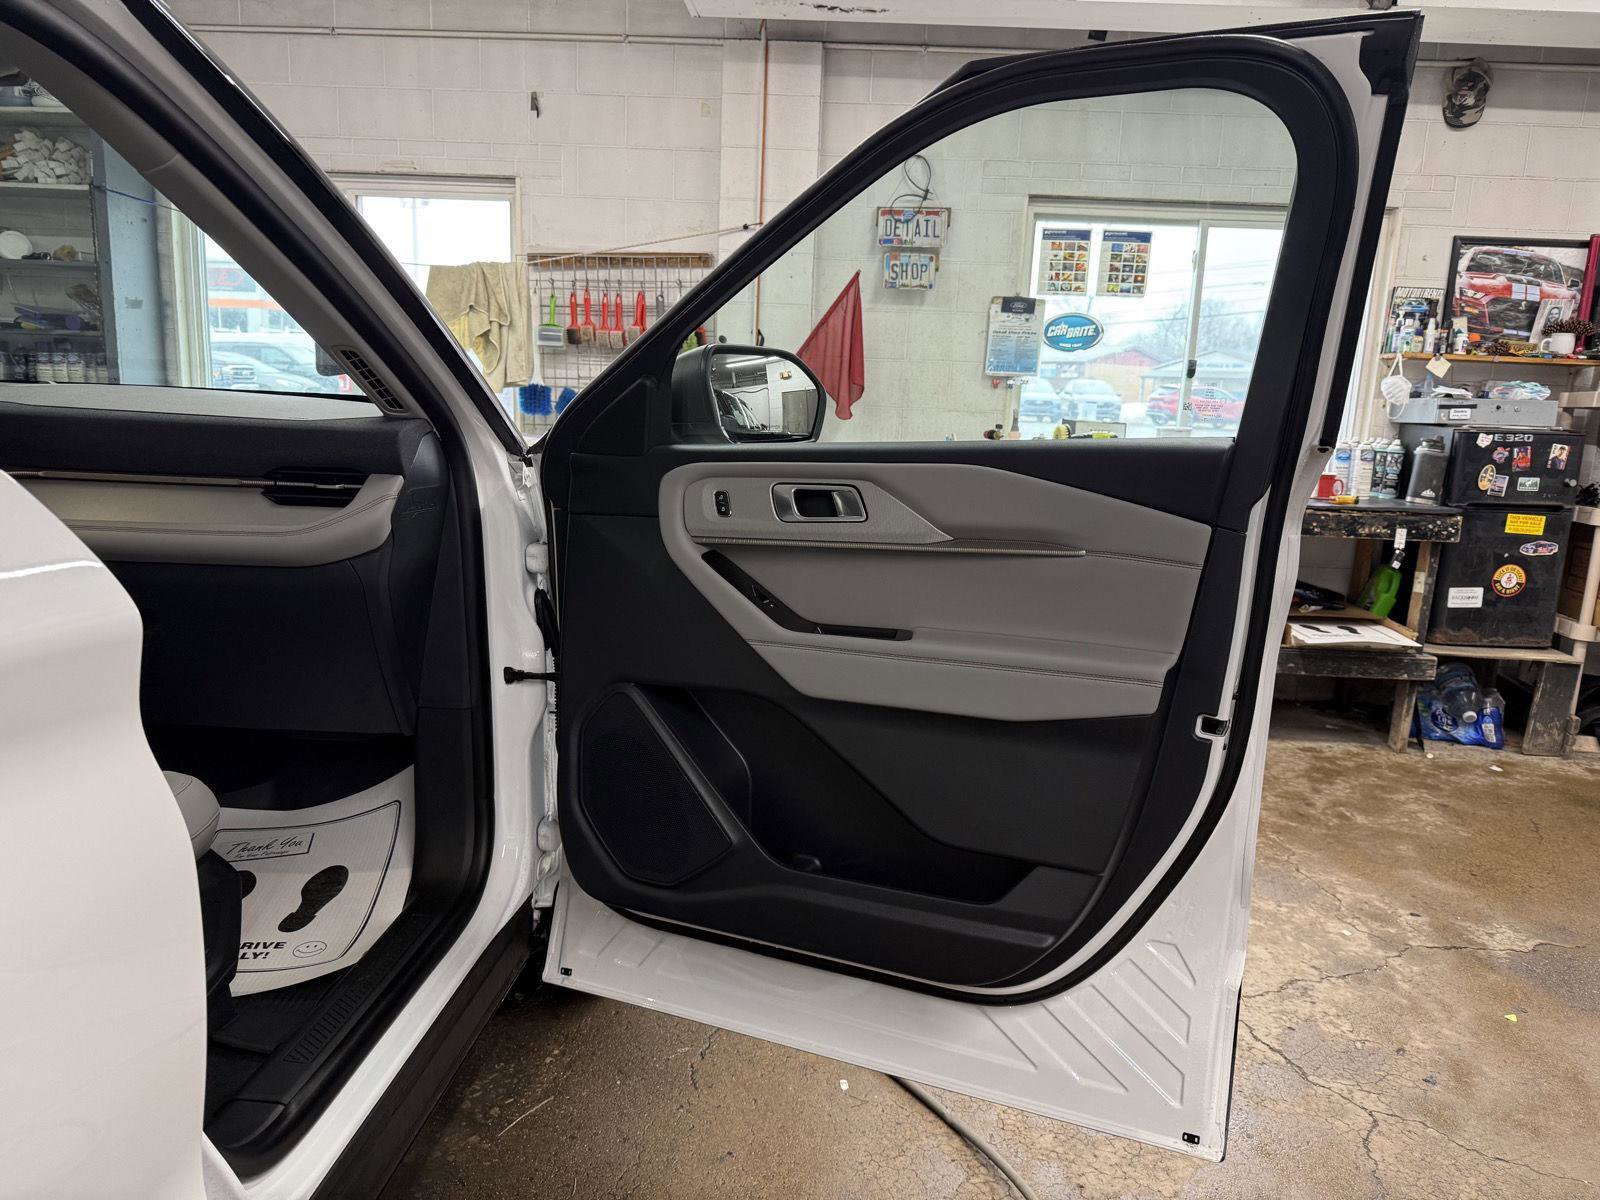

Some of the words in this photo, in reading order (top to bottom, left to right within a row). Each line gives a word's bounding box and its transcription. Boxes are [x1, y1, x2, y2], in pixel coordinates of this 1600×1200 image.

[885, 218, 940, 238] DETAIL
[891, 263, 928, 281] SHOP
[226, 839, 279, 855] Thank
[280, 836, 303, 849] You
[239, 941, 287, 949] RIVE
